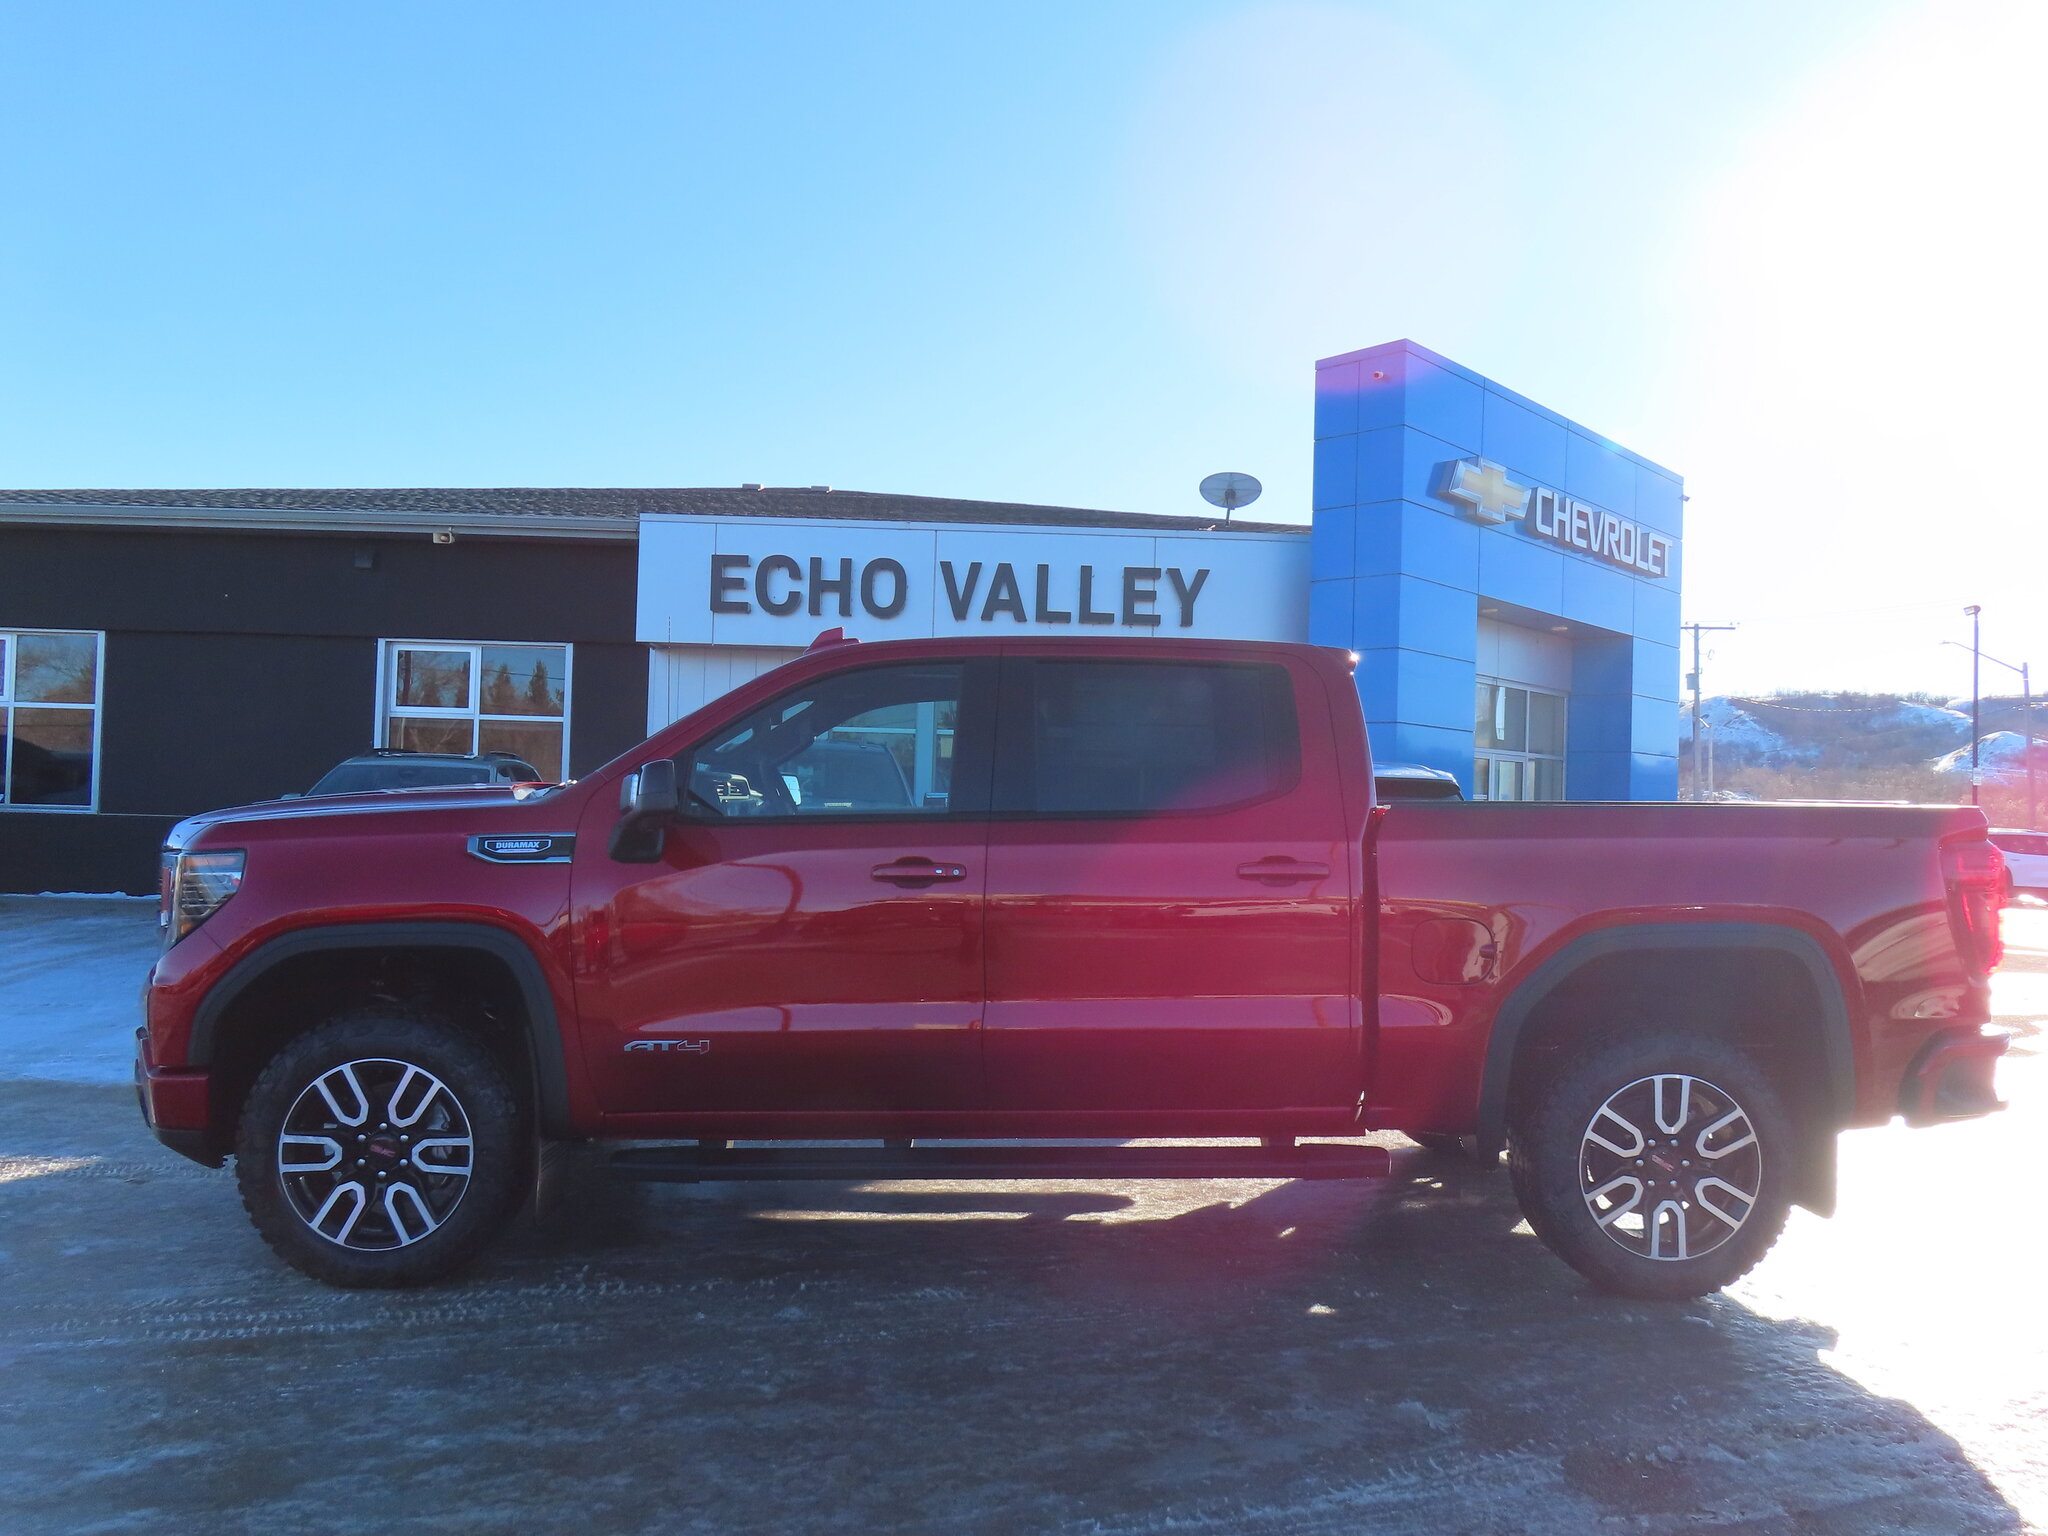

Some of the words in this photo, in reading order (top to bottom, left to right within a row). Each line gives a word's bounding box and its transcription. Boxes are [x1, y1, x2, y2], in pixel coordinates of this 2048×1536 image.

[1536, 486, 1673, 577] CHEVROLET
[710, 555, 908, 619] ECHO
[940, 561, 1210, 627] VALLEY
[495, 841, 540, 849] DURAMAX
[624, 1039, 710, 1055] AT4
